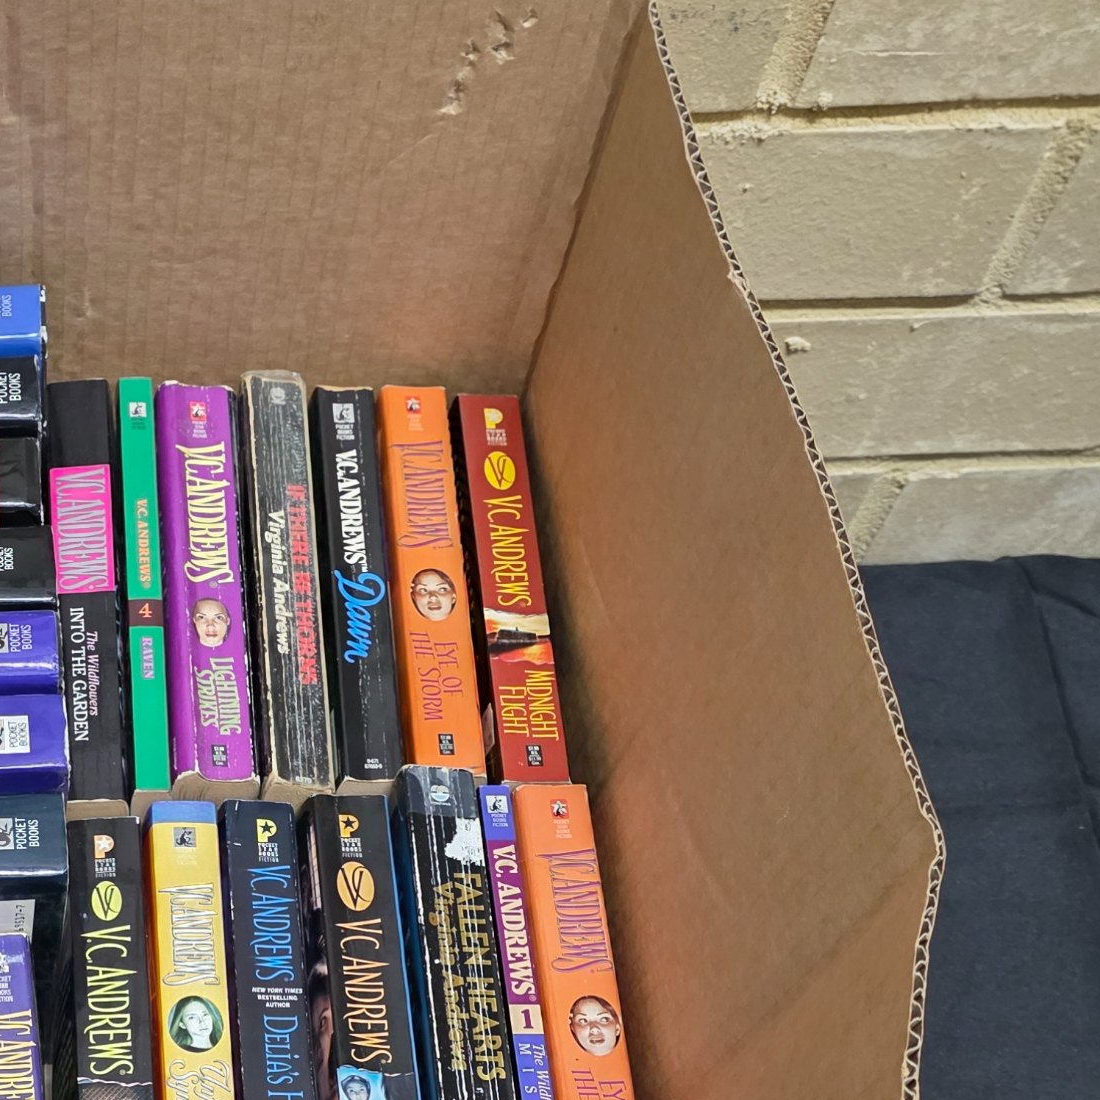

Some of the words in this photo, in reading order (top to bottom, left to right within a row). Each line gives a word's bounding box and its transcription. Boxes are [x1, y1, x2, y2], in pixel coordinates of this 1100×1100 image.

[9, 372, 22, 402] BOOKS
[286, 484, 306, 502] IF
[137, 520, 151, 583] ANDREWS
[264, 509, 287, 574] Virginia
[289, 504, 310, 565] THERE
[69, 606, 85, 644] INTO
[85, 630, 98, 652] The
[138, 602, 153, 619] 4
[271, 578, 294, 655] Andrews
[333, 569, 386, 664] Dawn
[71, 646, 87, 677] THE
[140, 636, 155, 680] RAVEN
[295, 600, 318, 686] THORNS
[409, 631, 435, 660] THE
[434, 640, 459, 670] EYE
[72, 679, 90, 742] GARDEN
[87, 651, 100, 717] Wildflowers
[195, 665, 219, 729] STRIKES
[209, 656, 242, 736] LIGHTNING
[417, 666, 445, 722] STORM
[441, 674, 463, 697] OF
[498, 685, 530, 738] FLIGHT
[523, 669, 560, 742] MIDNIGHT
[429, 880, 456, 966] Virginia
[453, 872, 492, 966] FALLEN
[497, 881, 537, 996] ANDREWS
[441, 967, 470, 1071] Andrews
[464, 976, 506, 1081] HEARTS
[520, 1008, 534, 1030] 1
[532, 1043, 545, 1067] The
